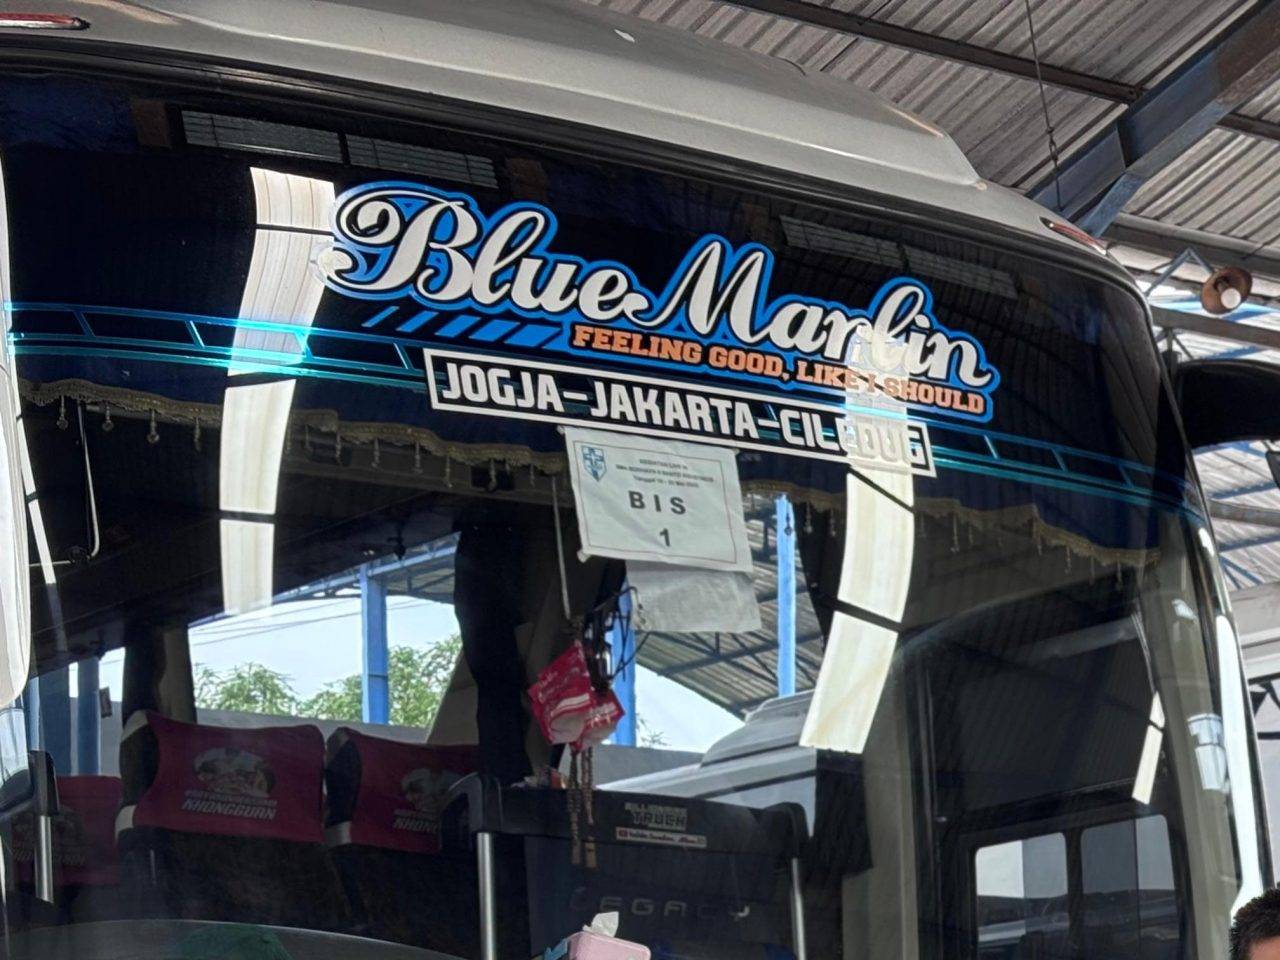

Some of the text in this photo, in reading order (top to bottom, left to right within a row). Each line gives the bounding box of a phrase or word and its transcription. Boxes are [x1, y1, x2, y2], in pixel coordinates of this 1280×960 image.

[317, 188, 993, 388] Blue Marlin
[573, 323, 702, 364] FEELING
[707, 345, 791, 383] GOOD,
[796, 360, 860, 391] LIKE
[883, 376, 986, 415] SHOULD
[659, 528, 671, 548] 1
